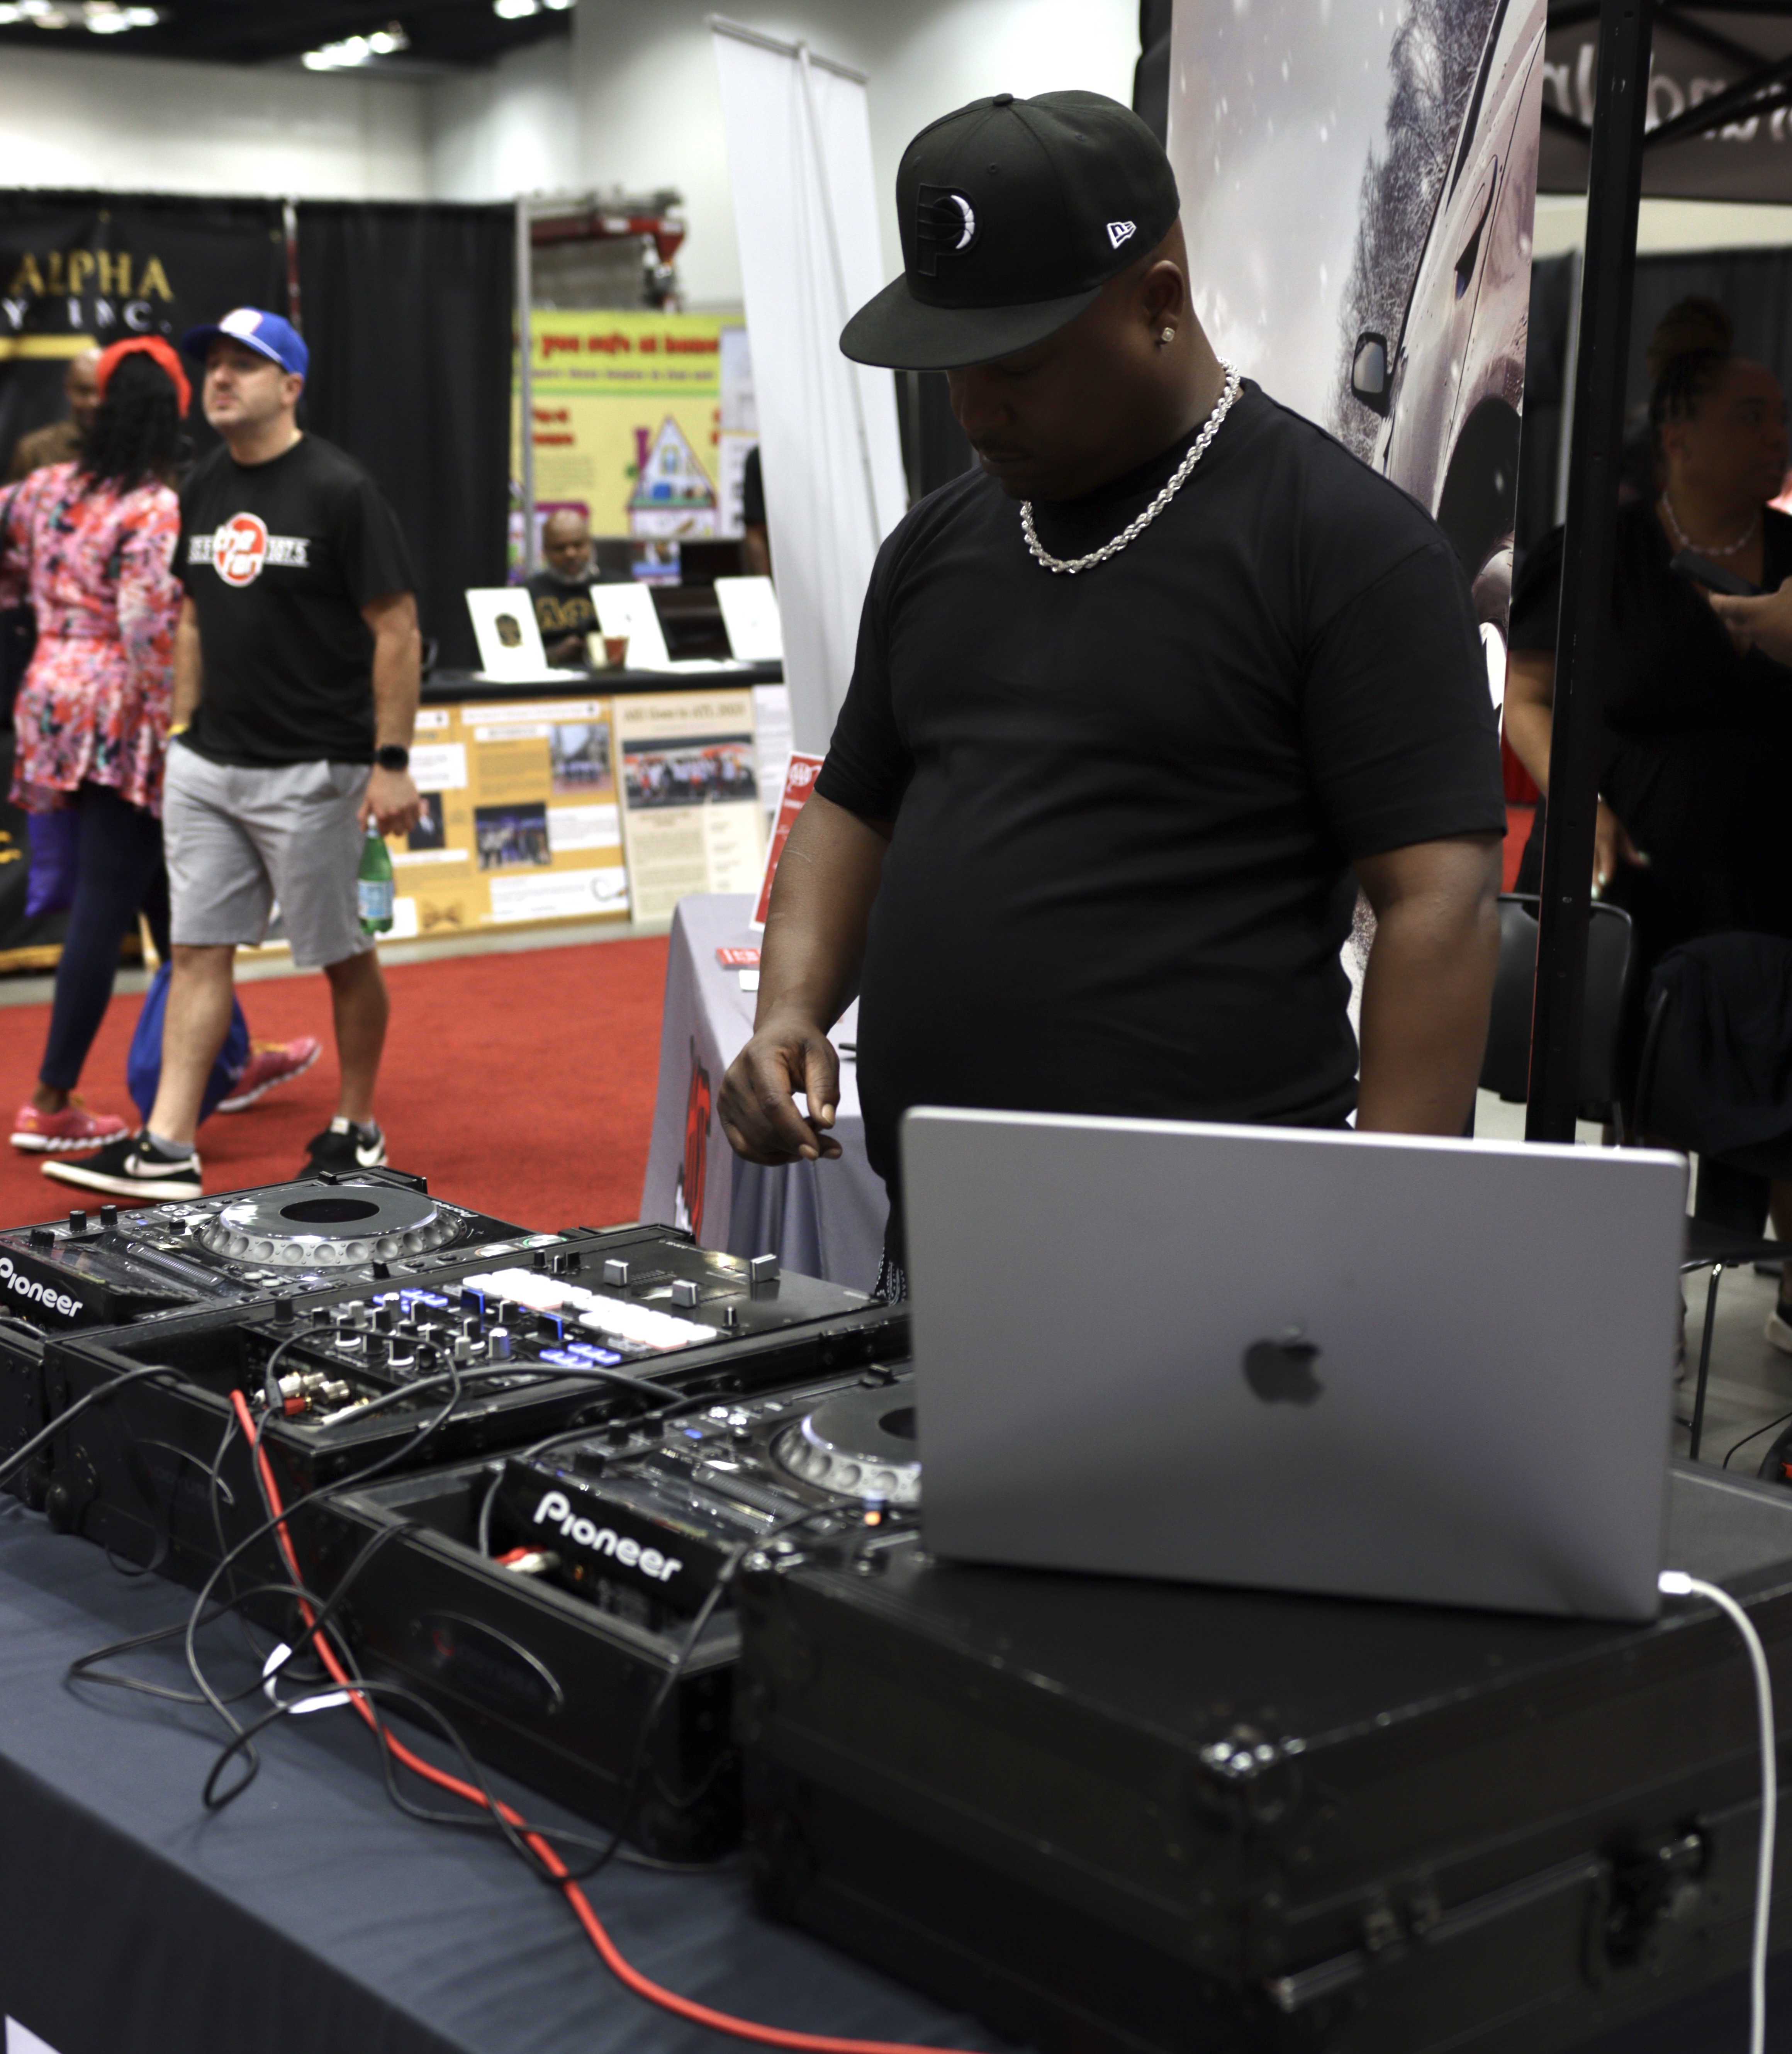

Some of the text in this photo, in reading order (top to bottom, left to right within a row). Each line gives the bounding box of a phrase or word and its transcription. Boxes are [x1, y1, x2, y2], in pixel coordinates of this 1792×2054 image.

[9, 249, 175, 302] ALPHA
[67, 297, 172, 333] INC.
[0, 1257, 83, 1317] Pioneer
[533, 1490, 683, 1582] Pioneer
